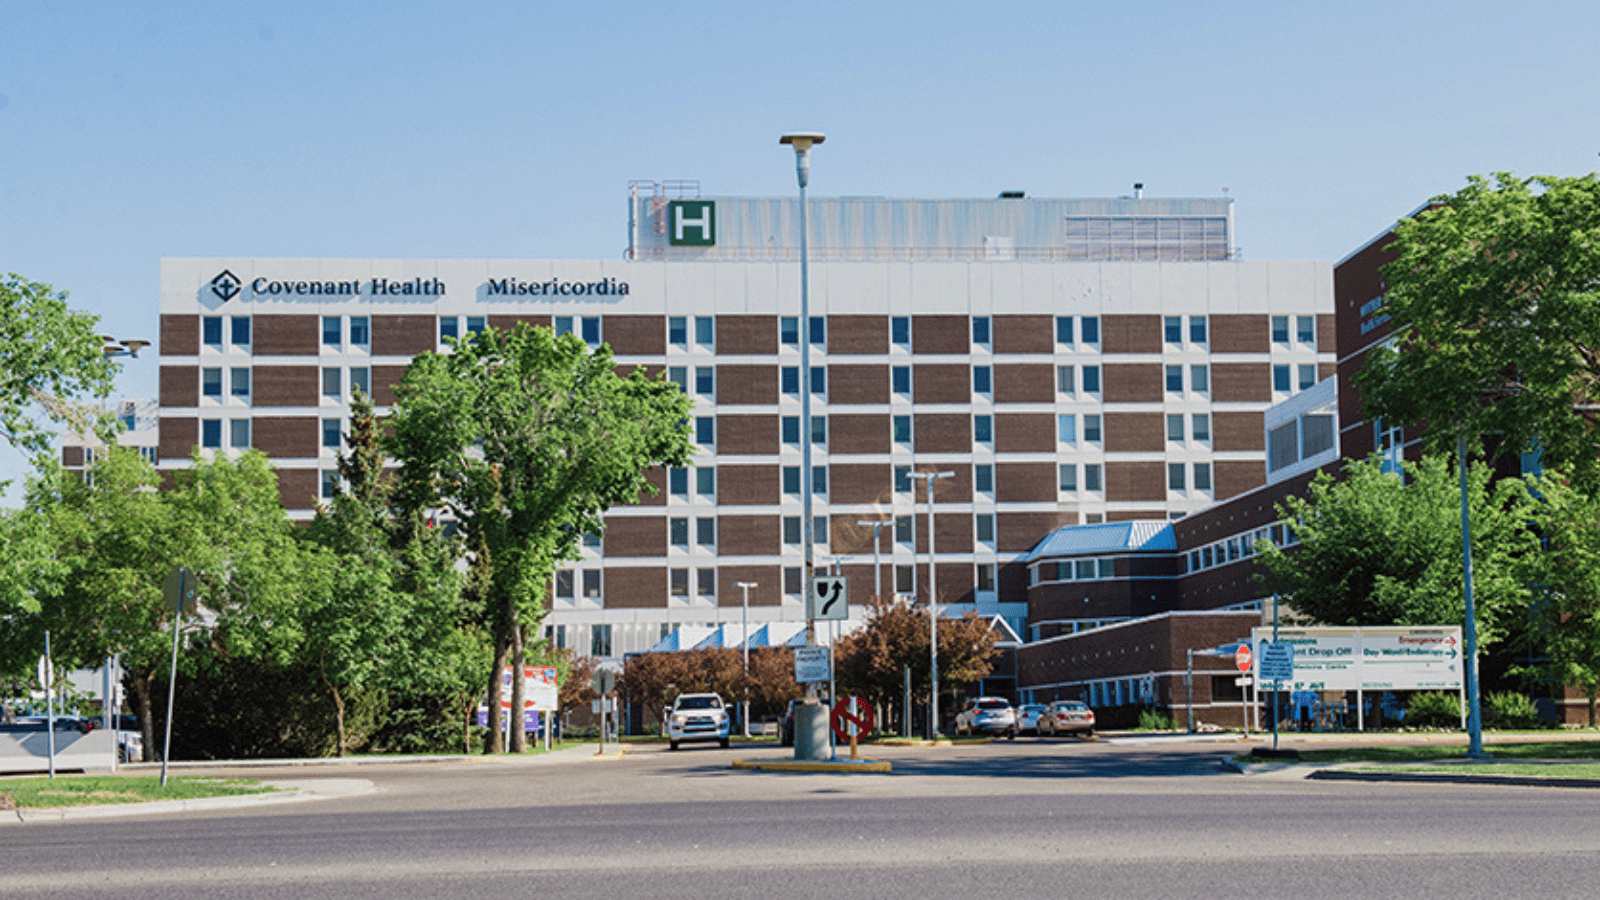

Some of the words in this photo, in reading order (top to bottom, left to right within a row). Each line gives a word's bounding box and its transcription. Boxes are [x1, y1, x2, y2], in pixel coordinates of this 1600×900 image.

[675, 206, 710, 240] H
[251, 277, 361, 296] Covenant
[371, 277, 446, 296] Health
[487, 277, 630, 296] Misericordia
[1308, 647, 1334, 657] Drop
[1335, 647, 1353, 656] Off
